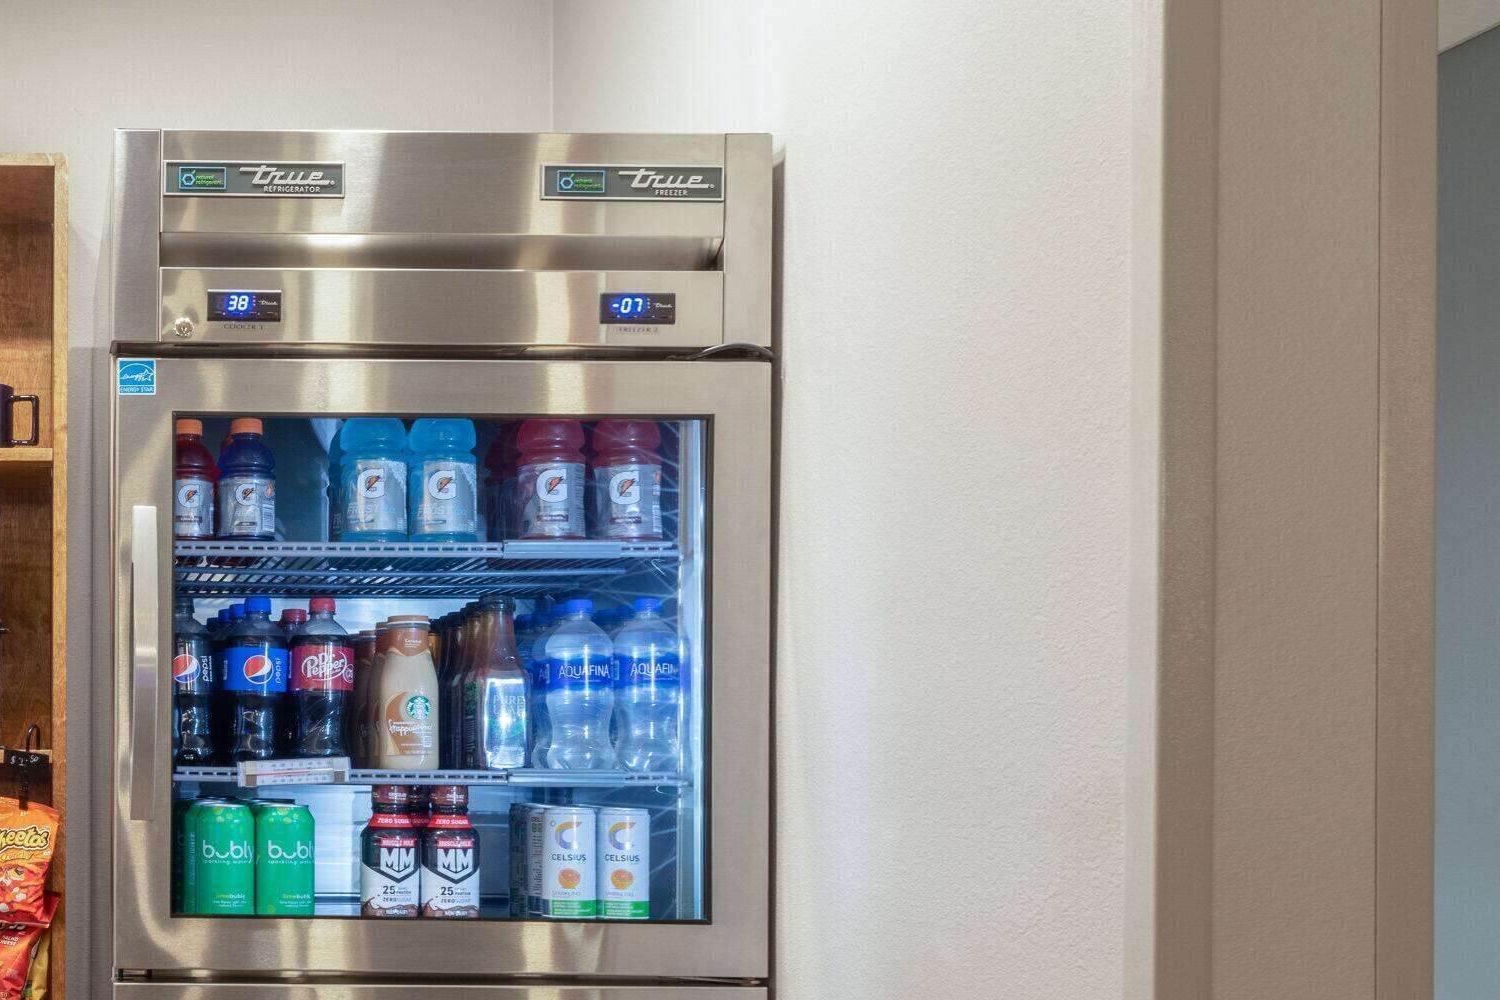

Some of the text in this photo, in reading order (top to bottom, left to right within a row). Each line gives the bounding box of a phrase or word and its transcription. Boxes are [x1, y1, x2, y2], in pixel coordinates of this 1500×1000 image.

[263, 185, 321, 193] REFRIGERATOR
[228, 295, 249, 311] 38
[611, 297, 644, 314] -07
[201, 655, 210, 682] pepsi
[274, 657, 282, 684] pepsi
[306, 656, 345, 678] Pepper
[558, 664, 611, 679] AQUAFINA
[202, 839, 254, 863] bubly
[551, 853, 587, 861] CELSIUS
[604, 854, 640, 862] CELSIUS
[382, 886, 396, 895] 25
[440, 887, 454, 896] 25
